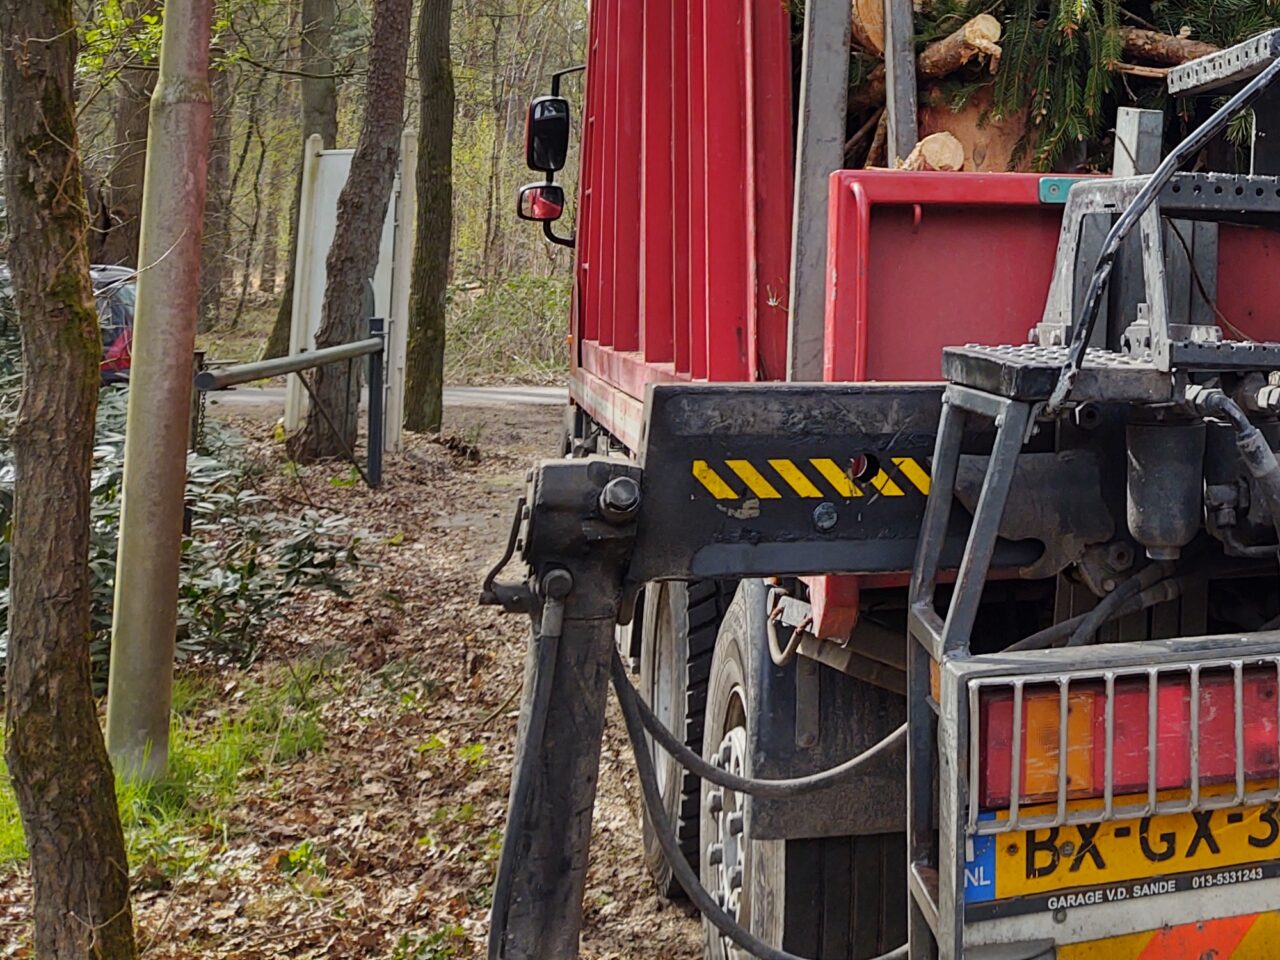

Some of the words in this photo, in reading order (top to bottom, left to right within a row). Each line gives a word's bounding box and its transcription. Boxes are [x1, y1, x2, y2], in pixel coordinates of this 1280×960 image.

[964, 866, 991, 888] NL
[1048, 890, 1104, 910] GARAGE
[1106, 887, 1130, 902] V.D.
[1132, 879, 1177, 898] SANDE
[1192, 867, 1264, 889] 013-5331243
